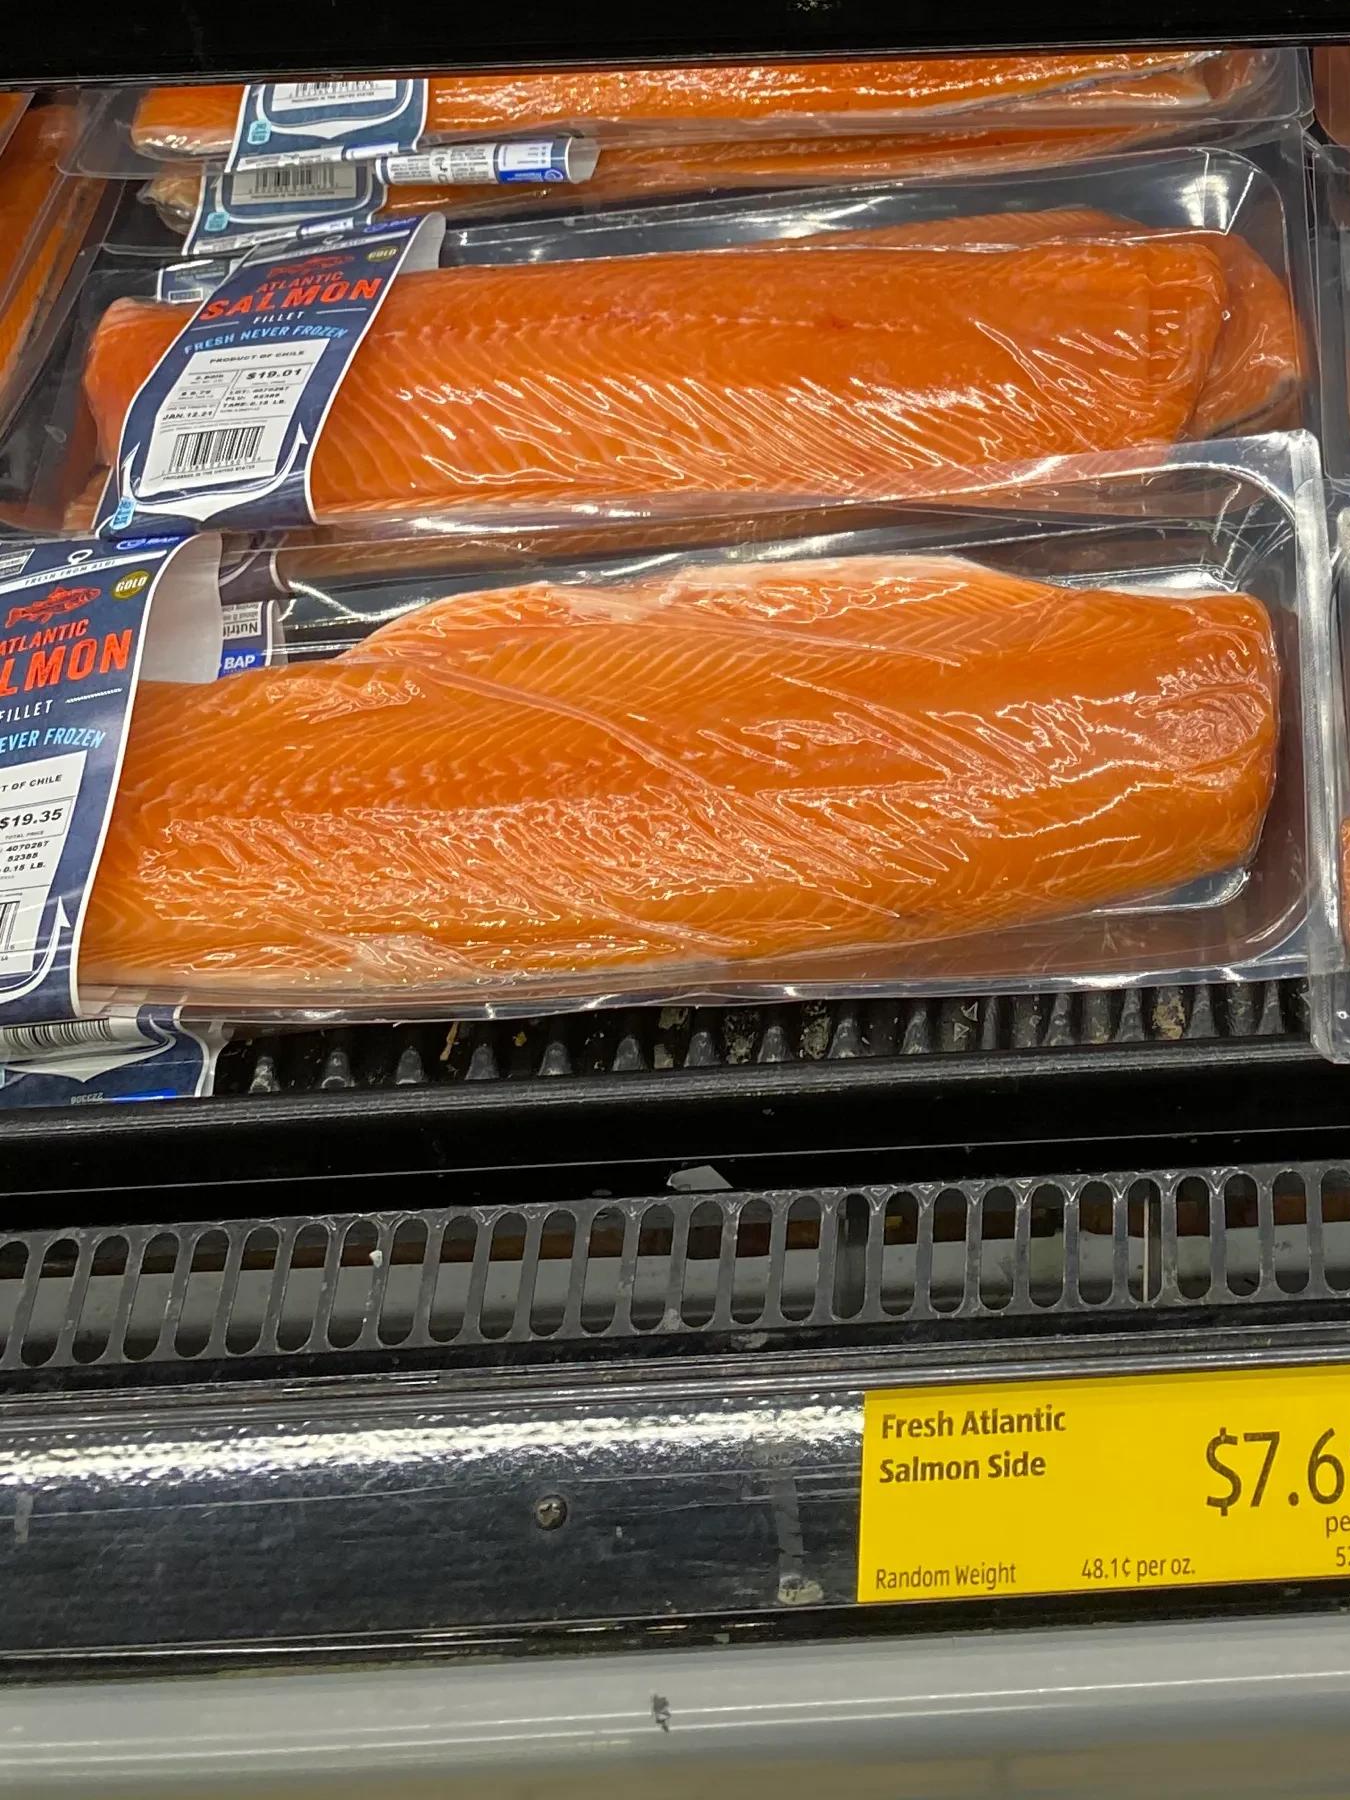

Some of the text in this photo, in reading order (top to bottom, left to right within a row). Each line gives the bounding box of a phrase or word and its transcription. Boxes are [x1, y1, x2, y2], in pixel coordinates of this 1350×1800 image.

[256, 269, 345, 293] ATLANTIC
[201, 277, 384, 320] SALMON
[184, 324, 349, 355] FRESH NEVER FROZEN
[245, 368, 303, 381] $19.01
[114, 574, 148, 595] GOLD
[0, 618, 89, 657] ATLANTIC
[224, 654, 256, 669] BAP
[45, 728, 106, 749] FROZEN
[29, 774, 63, 786] CHILE
[0, 807, 63, 829] $19.35
[881, 1404, 1066, 1439] Fresh Atlantic
[879, 1452, 1047, 1484] Salmon Side
[875, 1563, 1016, 1591] Random Weight
[1081, 1557, 1196, 1581] 48.1¢ per oz.
